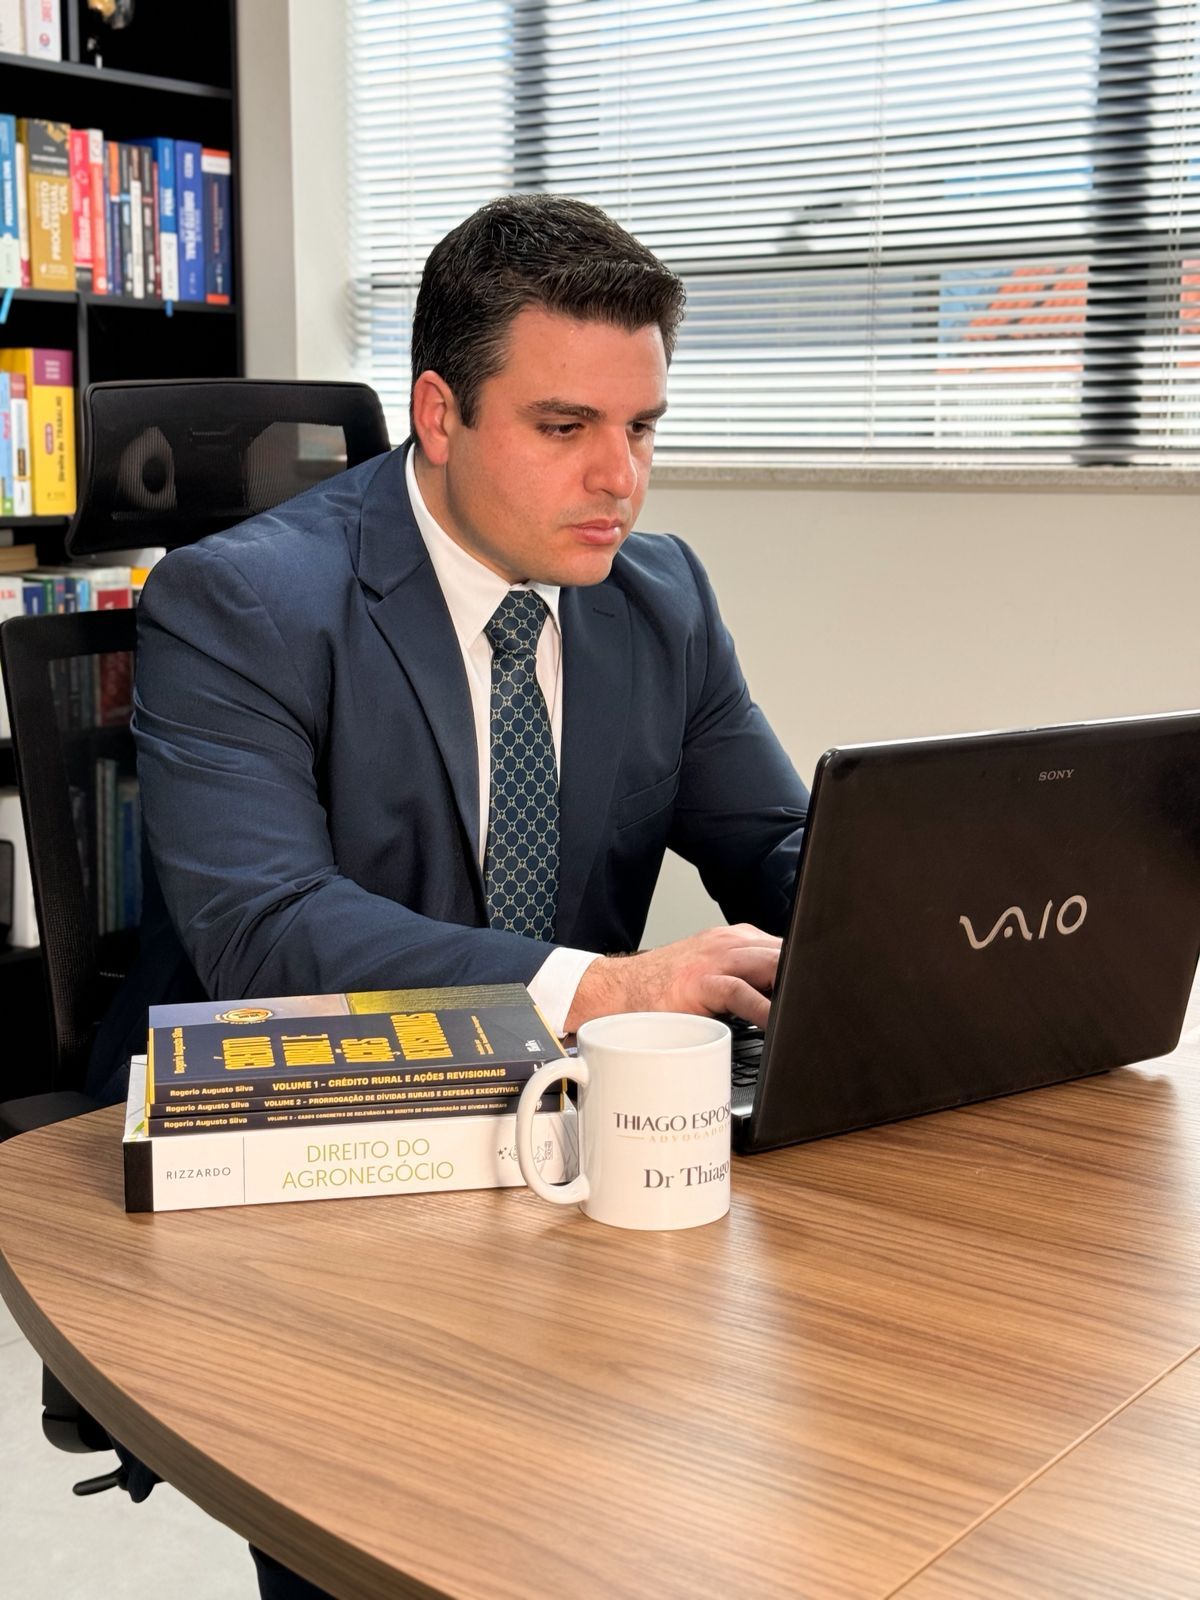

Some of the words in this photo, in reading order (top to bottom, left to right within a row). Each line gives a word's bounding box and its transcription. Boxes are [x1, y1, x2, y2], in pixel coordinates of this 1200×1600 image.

[41, 181, 51, 229] DIREITO
[58, 183, 68, 214] CIVIL
[50, 184, 62, 261] PROCESSUAL
[1038, 769, 1075, 781] SONY
[959, 895, 1088, 950] VAIO
[272, 1081, 312, 1091] VOLUME
[314, 1081, 319, 1089] 1
[328, 1077, 369, 1088] CRÉDITO
[371, 1075, 403, 1085] RURAL
[413, 1071, 444, 1083] AÇÕES
[447, 1068, 507, 1080] REVISIONAIS
[170, 1088, 200, 1097] Rogerio
[202, 1086, 234, 1096] Augusto
[264, 1099, 295, 1107] VOLUME
[308, 1094, 364, 1105] PRORROGAÇÃO
[376, 1092, 406, 1100] DÍVIDAS
[408, 1090, 435, 1099] RURAIS
[443, 1088, 474, 1096] DEFESAS
[476, 1085, 519, 1095] EXECUTIVAS
[165, 1104, 196, 1113] Rogerio
[197, 1102, 229, 1112] Augusto
[231, 1101, 249, 1109] Silva
[164, 1120, 194, 1129] Rogerio
[195, 1118, 228, 1128] Augusto
[229, 1117, 248, 1125] Silva
[613, 1111, 687, 1132] THIAGO
[306, 1140, 390, 1163] DIREITO
[396, 1138, 430, 1157] DO
[166, 1166, 232, 1180] RIZZARDO
[282, 1159, 455, 1190] AGRONEGÓCIO
[643, 1168, 674, 1189] Dr
[680, 1160, 730, 1187] Thiago
